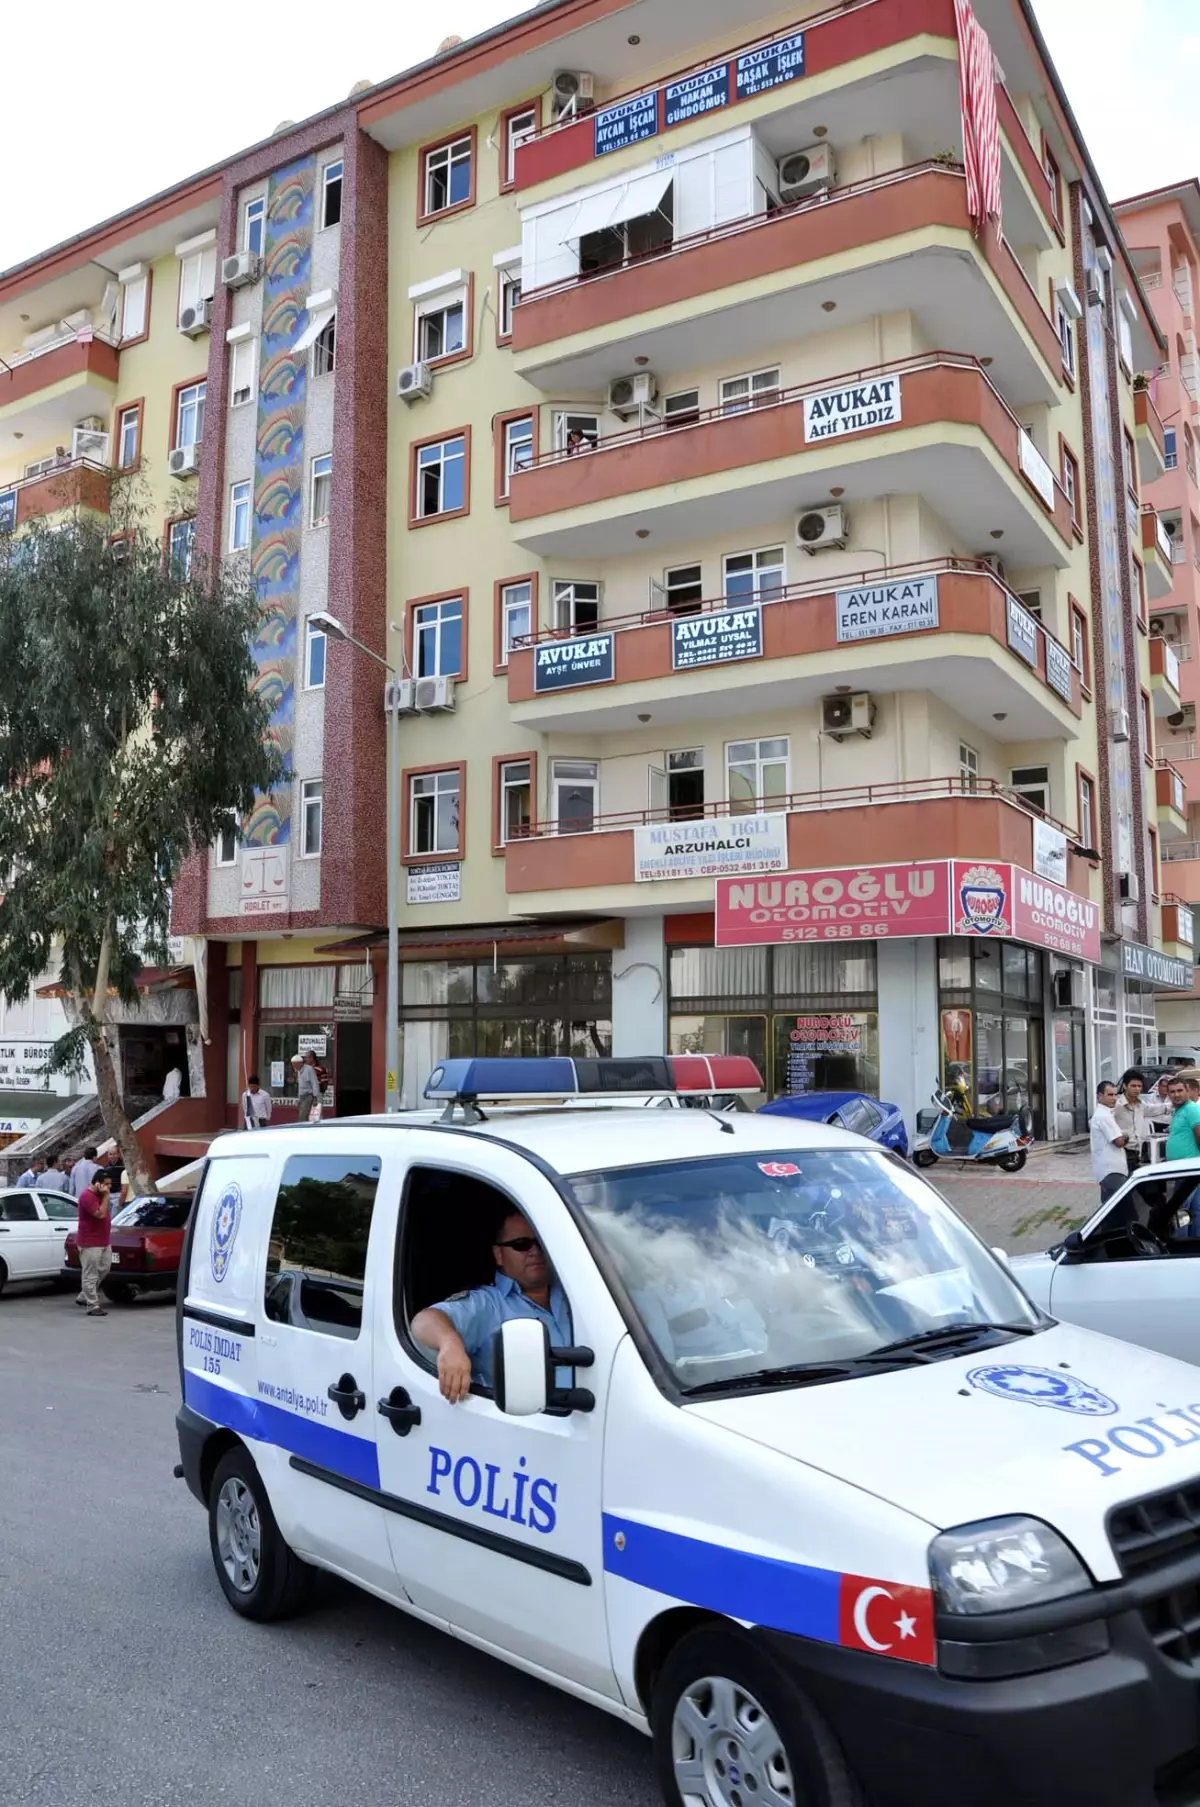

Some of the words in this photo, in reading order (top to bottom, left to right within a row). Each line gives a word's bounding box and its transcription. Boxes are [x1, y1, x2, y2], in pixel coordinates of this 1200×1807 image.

[742, 39, 797, 67] AVUKAT
[736, 62, 769, 87] BAŞAK
[777, 49, 803, 74] İŞLEK
[670, 69, 722, 97] AVUKAT
[680, 85, 713, 107] HAKAN
[601, 98, 650, 124] AVUKAT
[667, 91, 726, 124] GÜNDOĞMUŞ
[597, 120, 625, 143] AYCAN
[629, 108, 655, 132] İŞCAN
[808, 380, 894, 420] AVUKAT
[808, 418, 838, 438] Arif
[841, 406, 894, 430] YILDIZ
[847, 582, 924, 608] AVUKAT
[675, 611, 757, 640] AVUKAT
[841, 610, 877, 627] EREN
[882, 597, 933, 620] KARANİ
[537, 639, 610, 666] AVUKAT
[682, 637, 717, 649] YILMAZ
[721, 631, 752, 643] UYSAL
[546, 664, 567, 675] AYŞE
[571, 659, 601, 671] ÜNVER
[650, 825, 718, 844] MUSTAFA
[664, 838, 751, 855] ARZUHALCI
[729, 870, 934, 910] NUROĞLU
[1020, 878, 1093, 929] NUROĞLU
[782, 927, 818, 940] 512
[824, 926, 852, 938] 68
[860, 923, 889, 936] 86
[1044, 933, 1058, 946] 512
[1124, 946, 1144, 975] HAN
[1146, 953, 1185, 986] OTOMOTİV
[189, 1326, 212, 1352] POLİS
[213, 1329, 241, 1362] İMDAT
[203, 1355, 221, 1375] 155
[257, 1379, 328, 1417] www.antalya.pol.tr
[426, 1446, 558, 1534] POLİS
